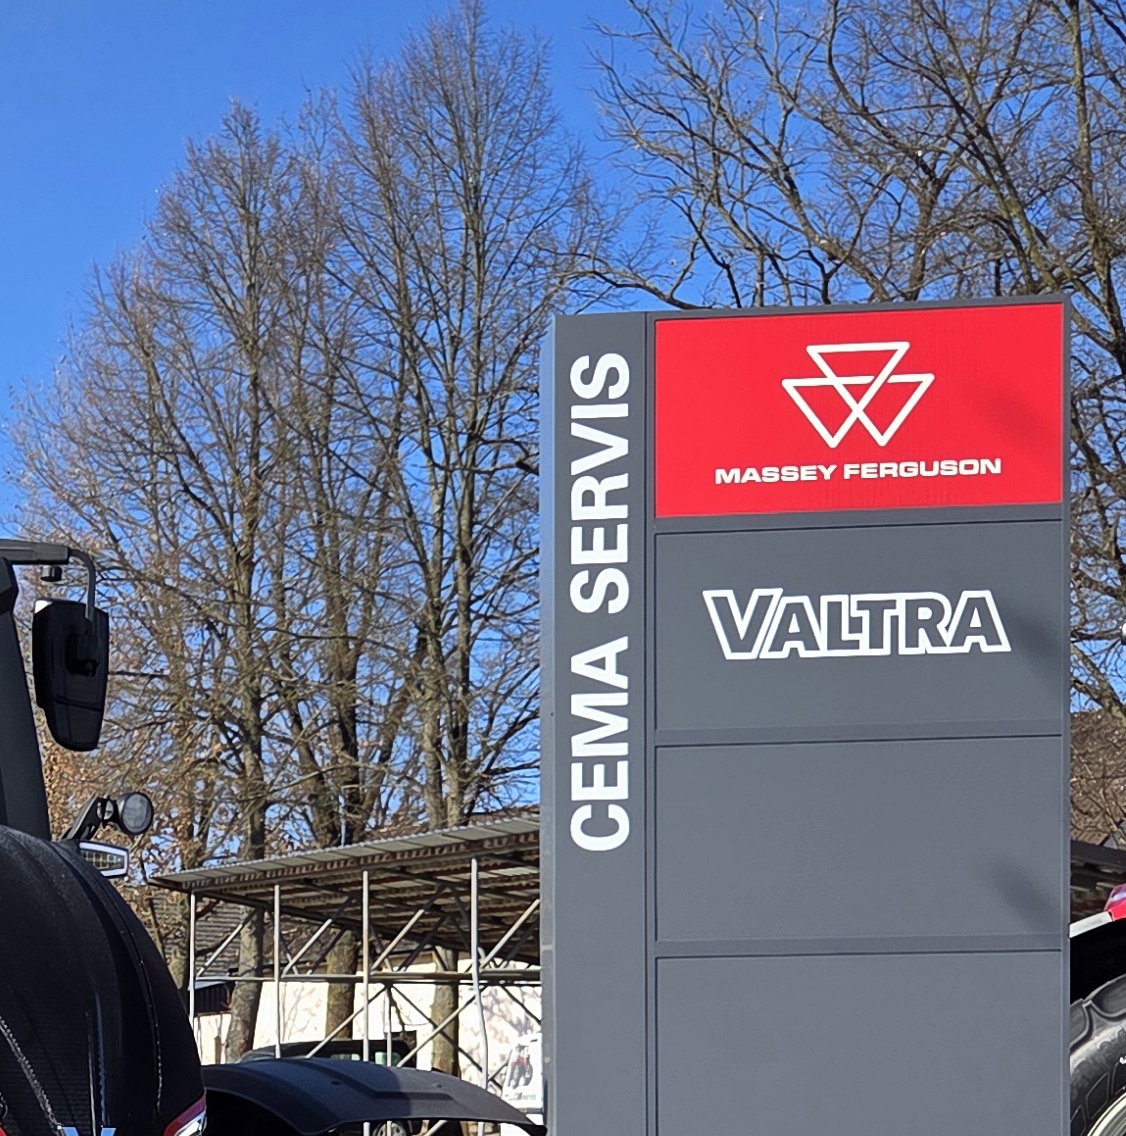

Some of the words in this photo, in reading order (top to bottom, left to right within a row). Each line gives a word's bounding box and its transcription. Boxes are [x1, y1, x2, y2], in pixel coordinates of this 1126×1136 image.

[570, 353, 630, 614] SERVIS
[715, 464, 837, 485] MASSEY
[843, 458, 1002, 480] FERGUSON
[702, 588, 1012, 660] VALTRA
[570, 636, 630, 851] CEMA
